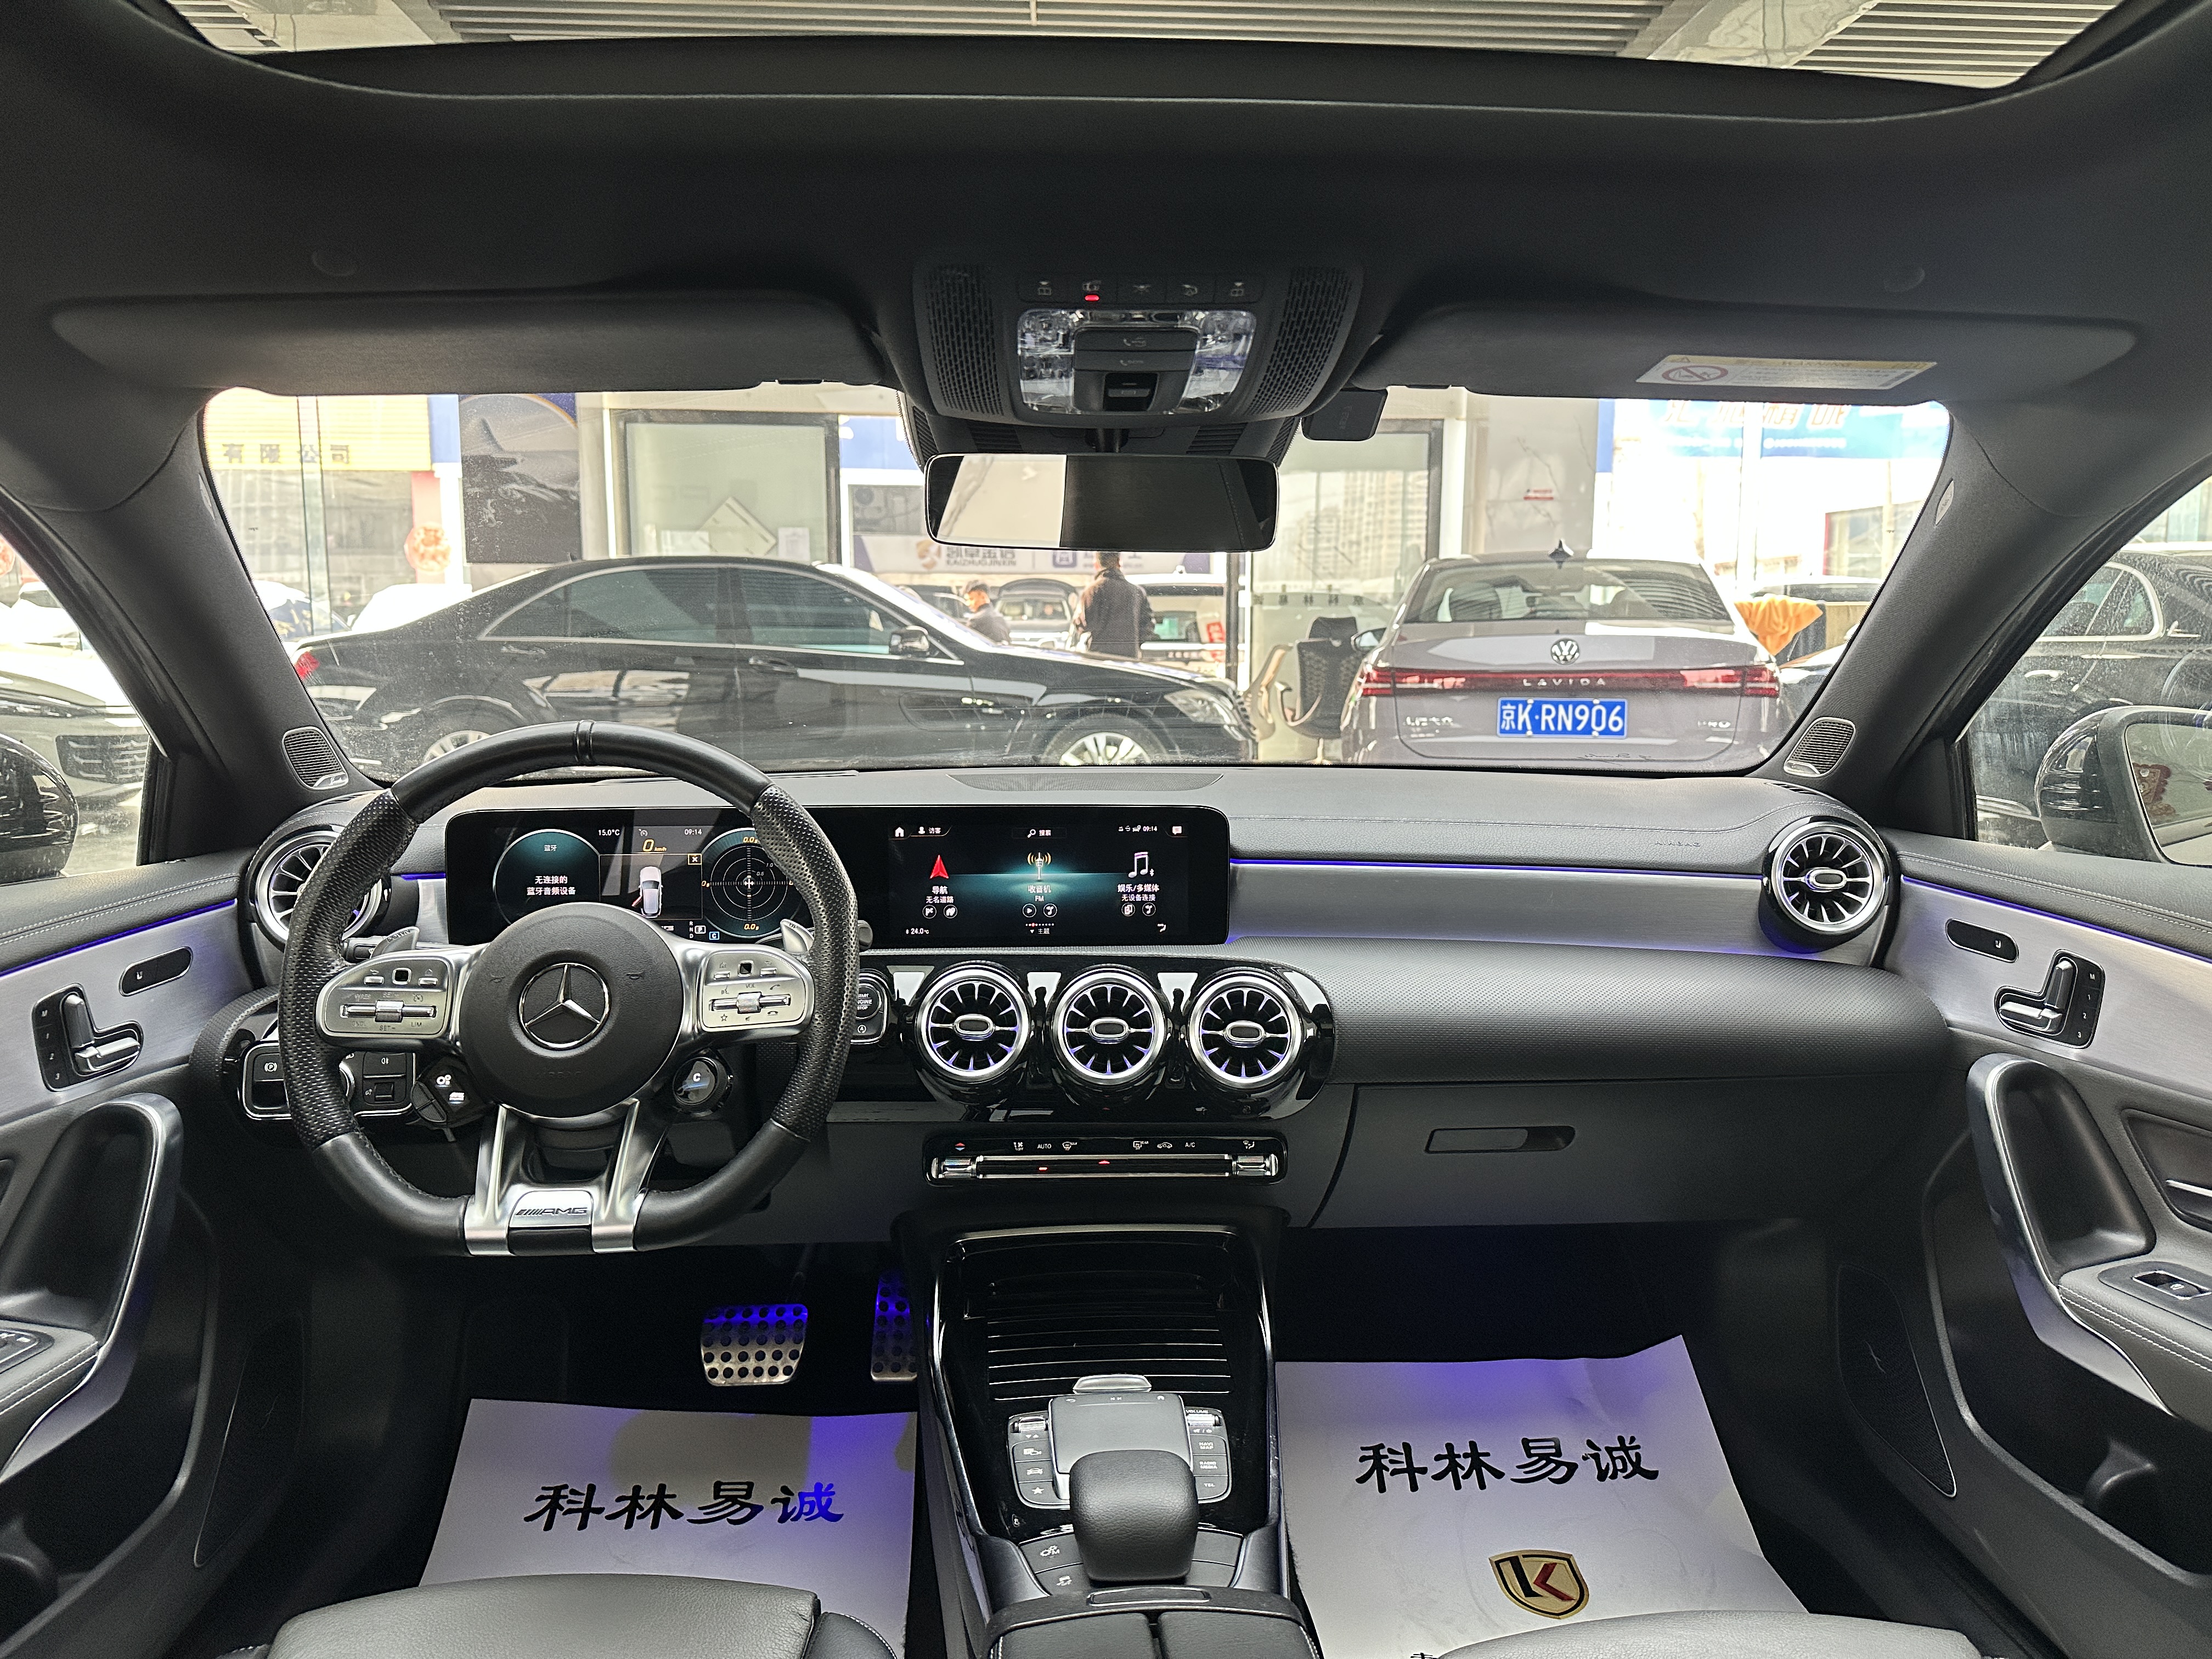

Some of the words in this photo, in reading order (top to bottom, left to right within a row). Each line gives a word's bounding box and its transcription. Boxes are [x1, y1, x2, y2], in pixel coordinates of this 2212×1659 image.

[222, 443, 350, 464] 有限公司
[1522, 678, 1606, 686] LAVIDA
[643, 839, 654, 852] 0
[534, 876, 568, 884] 无连接的
[526, 887, 576, 895] 蓝牙音频设备
[932, 885, 948, 895] 导航
[1028, 885, 1052, 894] 收音机
[926, 895, 954, 904] 无名道路
[386, 929, 411, 943] DOWN
[693, 1073, 701, 1082] C
[1355, 1435, 1659, 1494] 科林易诚
[523, 1480, 845, 1531] 科林易诚
